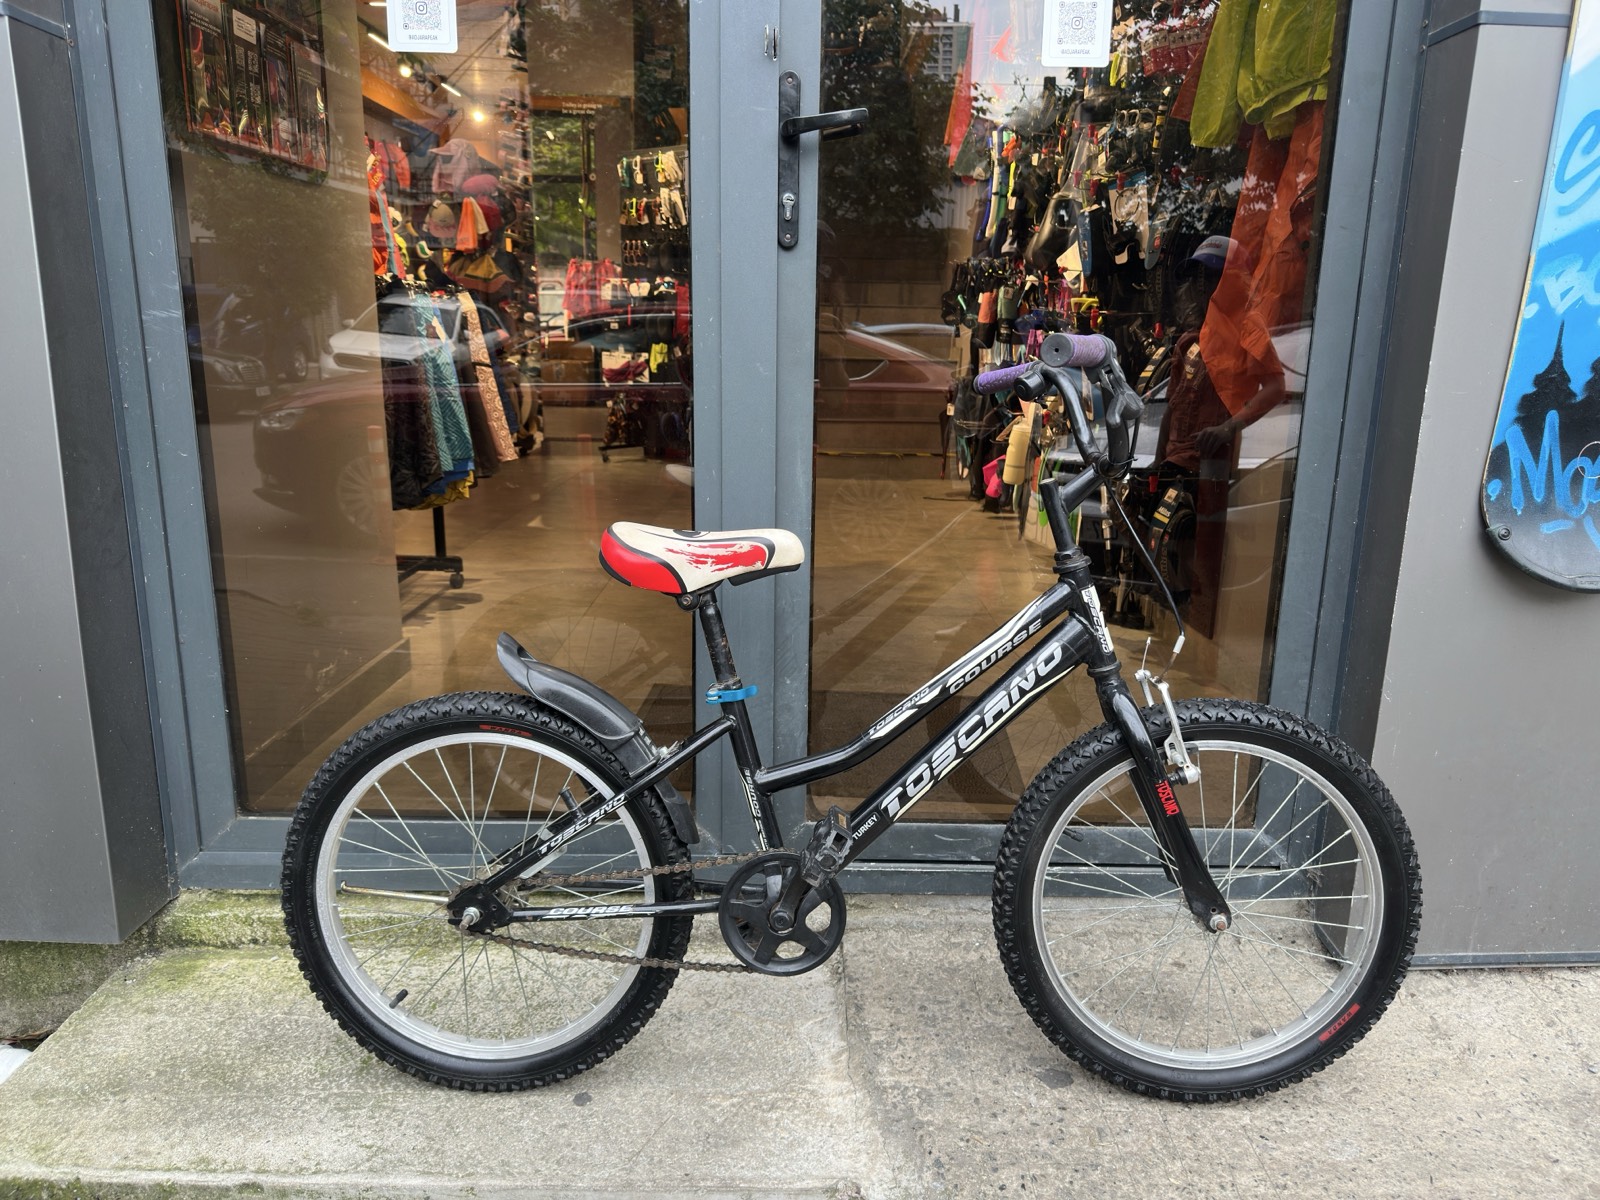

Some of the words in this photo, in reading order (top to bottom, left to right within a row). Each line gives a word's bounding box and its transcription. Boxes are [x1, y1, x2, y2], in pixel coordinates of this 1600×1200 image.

[949, 618, 1042, 695] COURSE
[868, 686, 931, 737] TOSCANO
[880, 641, 1063, 818] TOSCANO
[744, 768, 762, 818] COURSE
[1154, 780, 1180, 815] TOSCANO
[539, 793, 625, 854] TOSCANO
[852, 814, 878, 841] TURKEY
[551, 904, 633, 915] COURSE
[1327, 1011, 1353, 1035] WANDA
